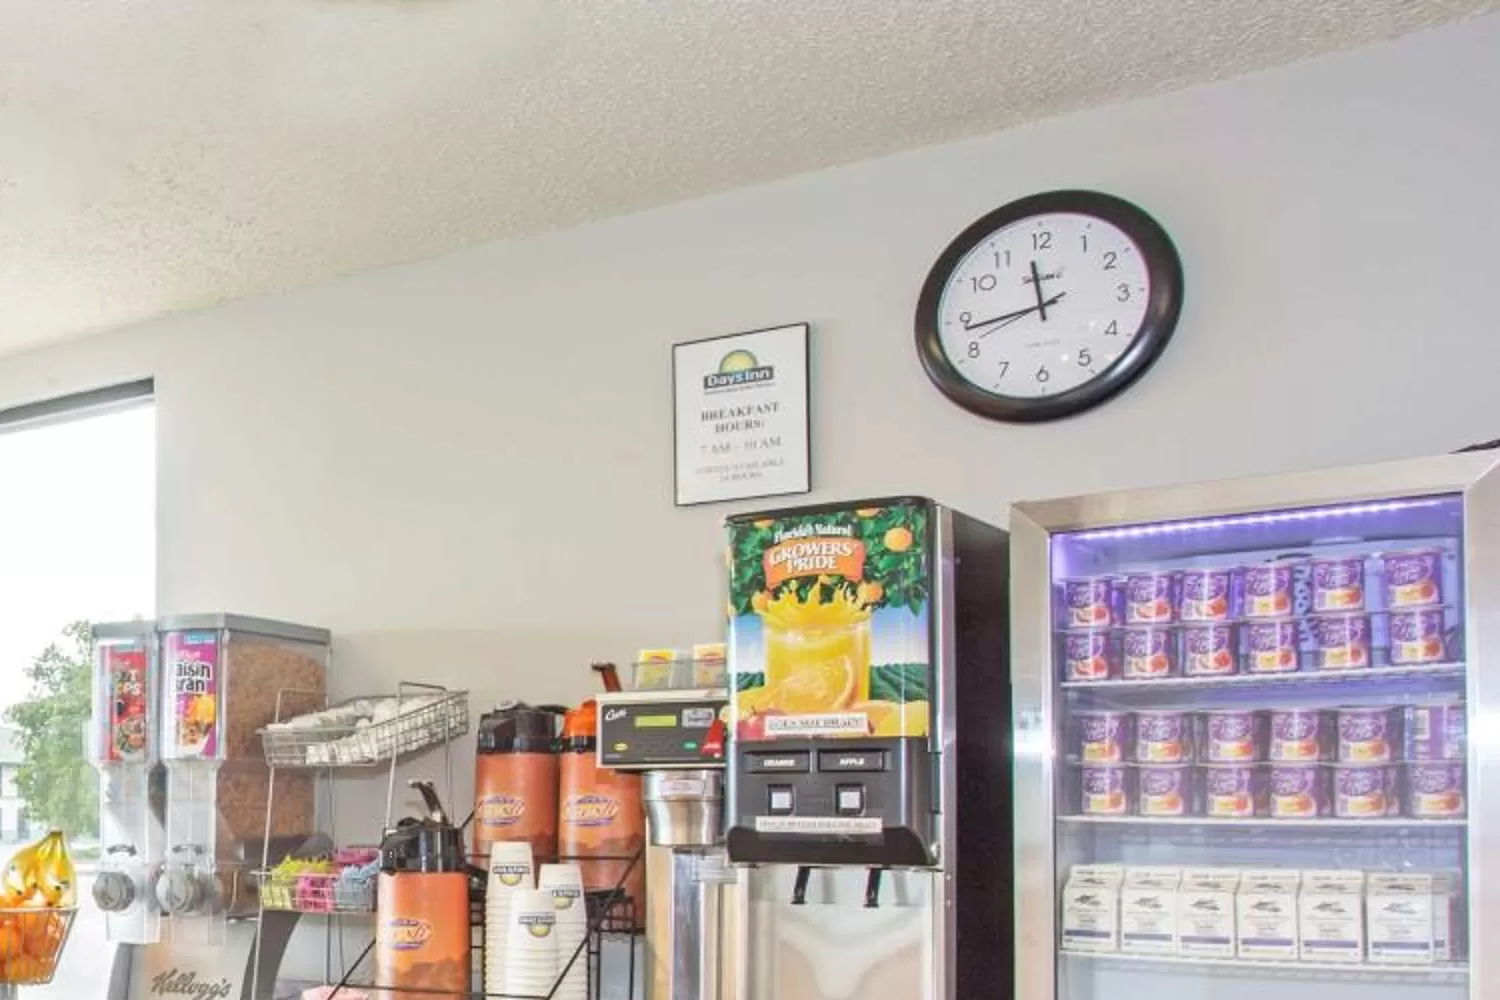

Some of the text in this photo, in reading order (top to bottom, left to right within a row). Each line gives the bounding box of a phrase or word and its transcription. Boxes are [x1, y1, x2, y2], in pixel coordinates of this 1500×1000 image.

[1031, 232, 1052, 250] 12
[1081, 235, 1088, 252] 1
[994, 250, 1011, 268] 11
[1103, 252, 1117, 270] 2
[972, 274, 996, 292] 10
[1117, 284, 1130, 302] 3
[959, 312, 972, 330] 9
[1104, 320, 1118, 336] 4
[967, 341, 980, 358] 8
[1078, 349, 1092, 367] 5
[707, 369, 771, 387] Days Inn
[998, 362, 1010, 378] 7
[1036, 366, 1049, 382] 6
[701, 401, 780, 422] BREAKFAST
[761, 435, 781, 448] AM
[768, 542, 853, 565] GROWERS
[786, 555, 838, 573] PRIDE
[173, 660, 211, 678] aisin
